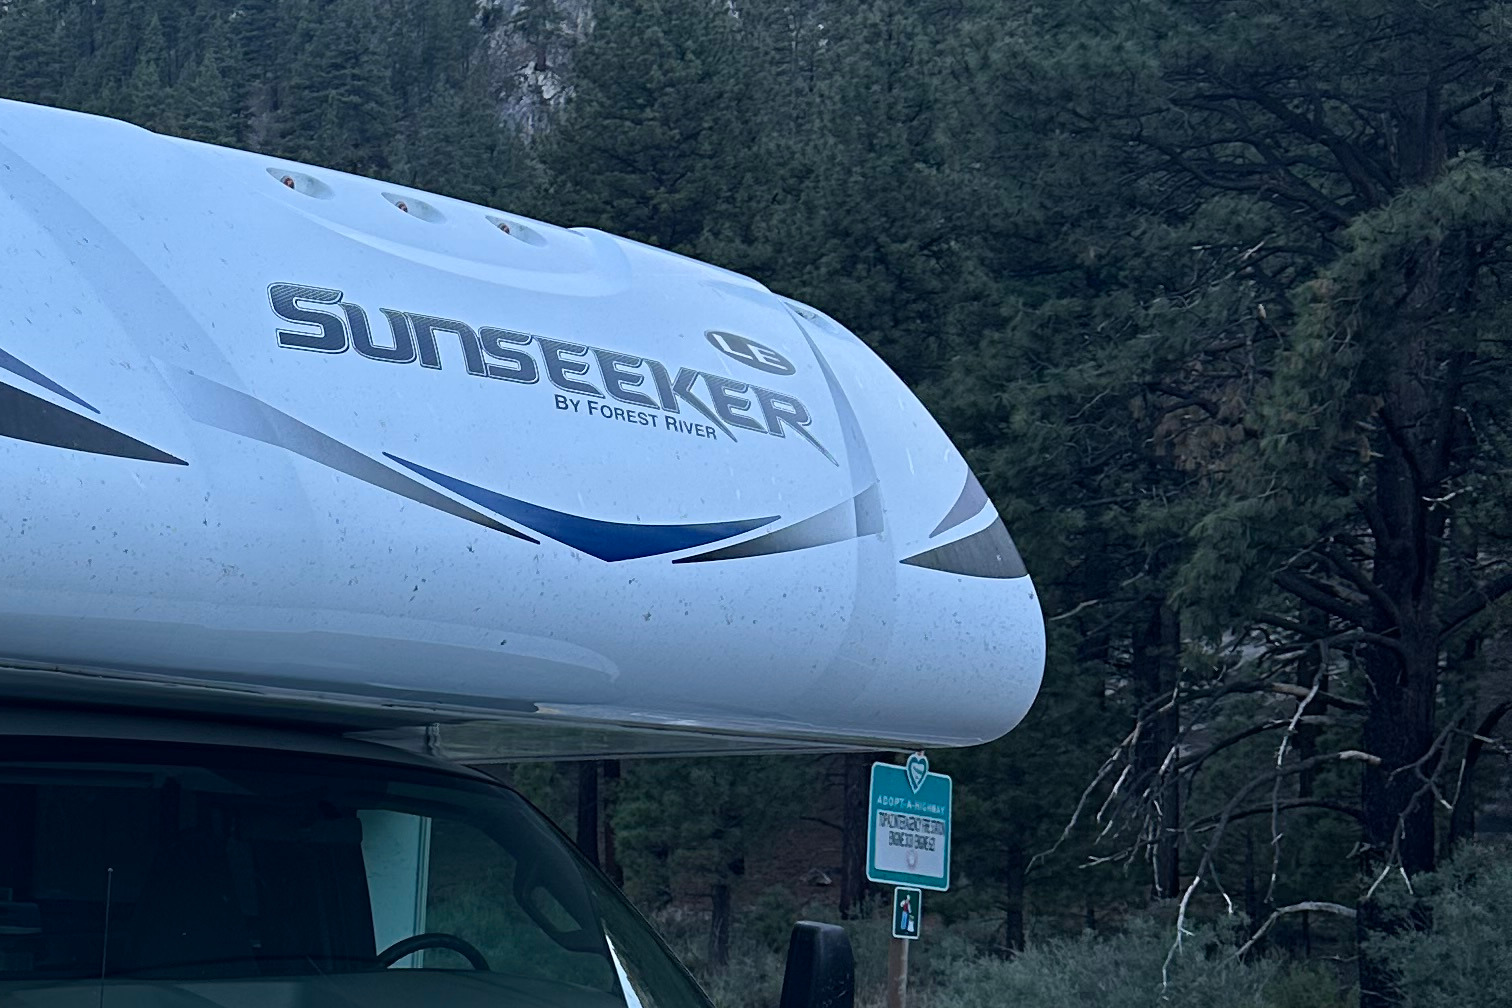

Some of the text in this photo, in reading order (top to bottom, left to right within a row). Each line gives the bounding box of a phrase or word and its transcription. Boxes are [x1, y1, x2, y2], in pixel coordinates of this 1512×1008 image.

[711, 333, 788, 372] LE
[554, 394, 718, 441] BY FOREST RIVER
